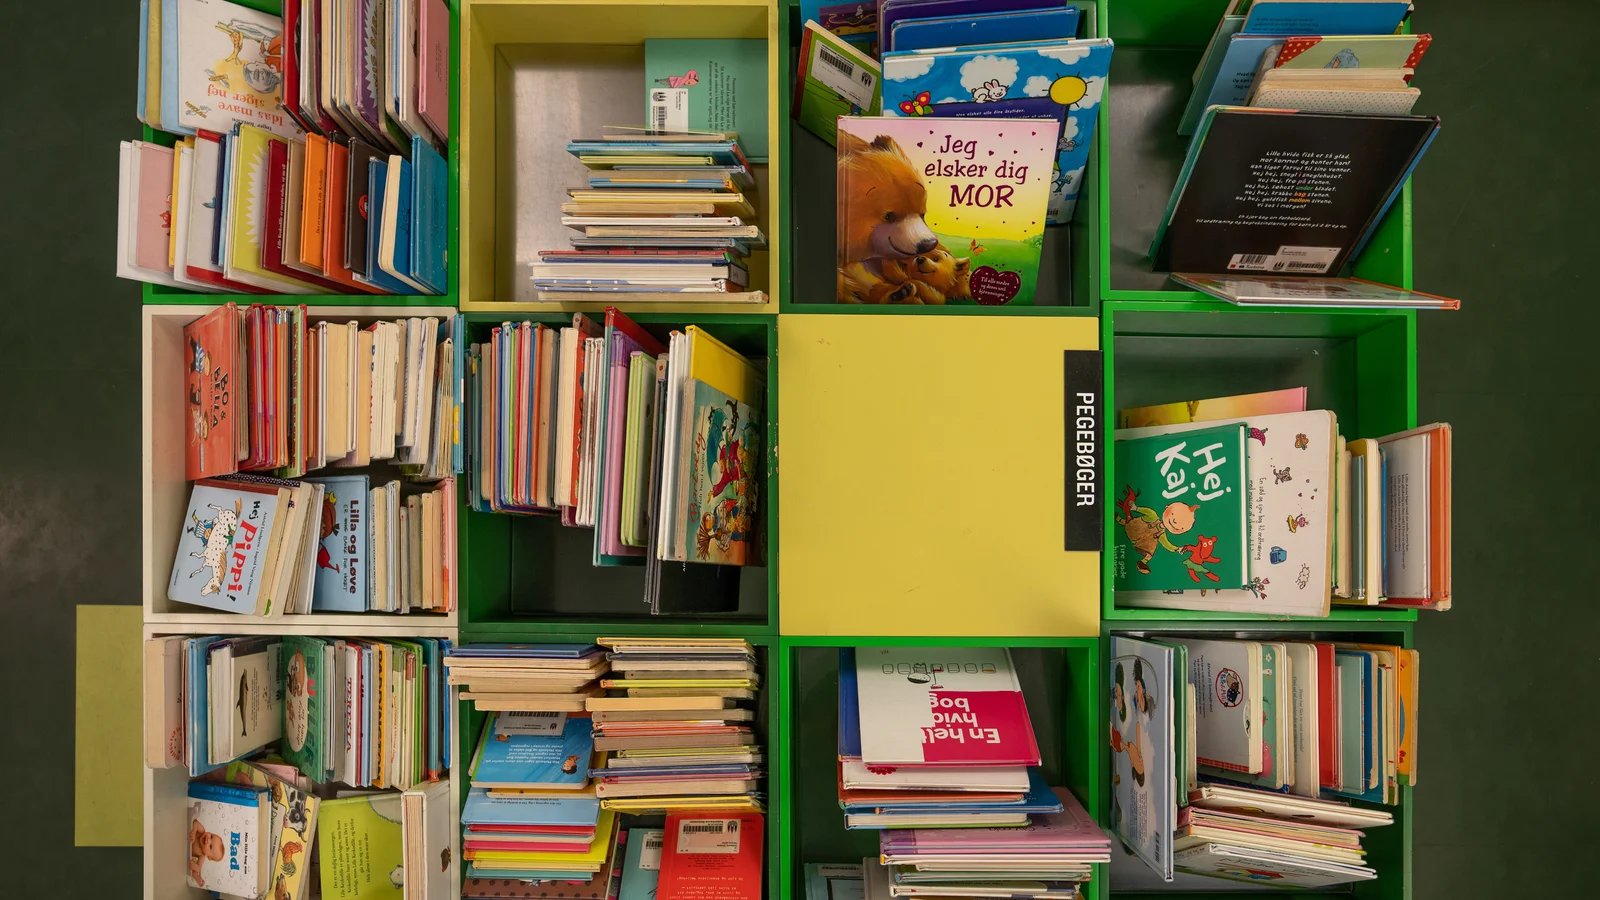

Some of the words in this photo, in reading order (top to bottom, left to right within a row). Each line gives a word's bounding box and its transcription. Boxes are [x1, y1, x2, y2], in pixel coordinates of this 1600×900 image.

[207, 84, 227, 98] nej
[232, 94, 265, 108] siger
[218, 102, 253, 117] mave
[258, 112, 284, 126] Idas
[939, 134, 978, 160] Jeg
[924, 159, 987, 178] elsker
[994, 160, 1029, 185] dig
[949, 184, 1014, 208] MOR
[221, 372, 229, 406] BO
[221, 410, 226, 420] &
[1076, 392, 1095, 507] PEGEBØGER
[689, 433, 706, 523] Bartoldy
[1155, 441, 1196, 499] Kaj
[1192, 442, 1232, 501] Hej
[248, 501, 261, 520] Hej
[350, 500, 359, 531] Lilla
[1256, 504, 1264, 514] sjov
[1256, 514, 1265, 523] bog
[348, 534, 357, 555] og
[1254, 532, 1264, 561] ordtræning
[227, 520, 258, 602] Pippi!
[1118, 561, 1127, 578] gode
[349, 558, 359, 594] Løve
[306, 656, 317, 767] BULLER
[928, 693, 970, 712] bog
[932, 712, 978, 727] hvid
[920, 728, 965, 744] helt
[968, 728, 1001, 744] En
[230, 832, 241, 871] Bad
[244, 866, 248, 874] om
